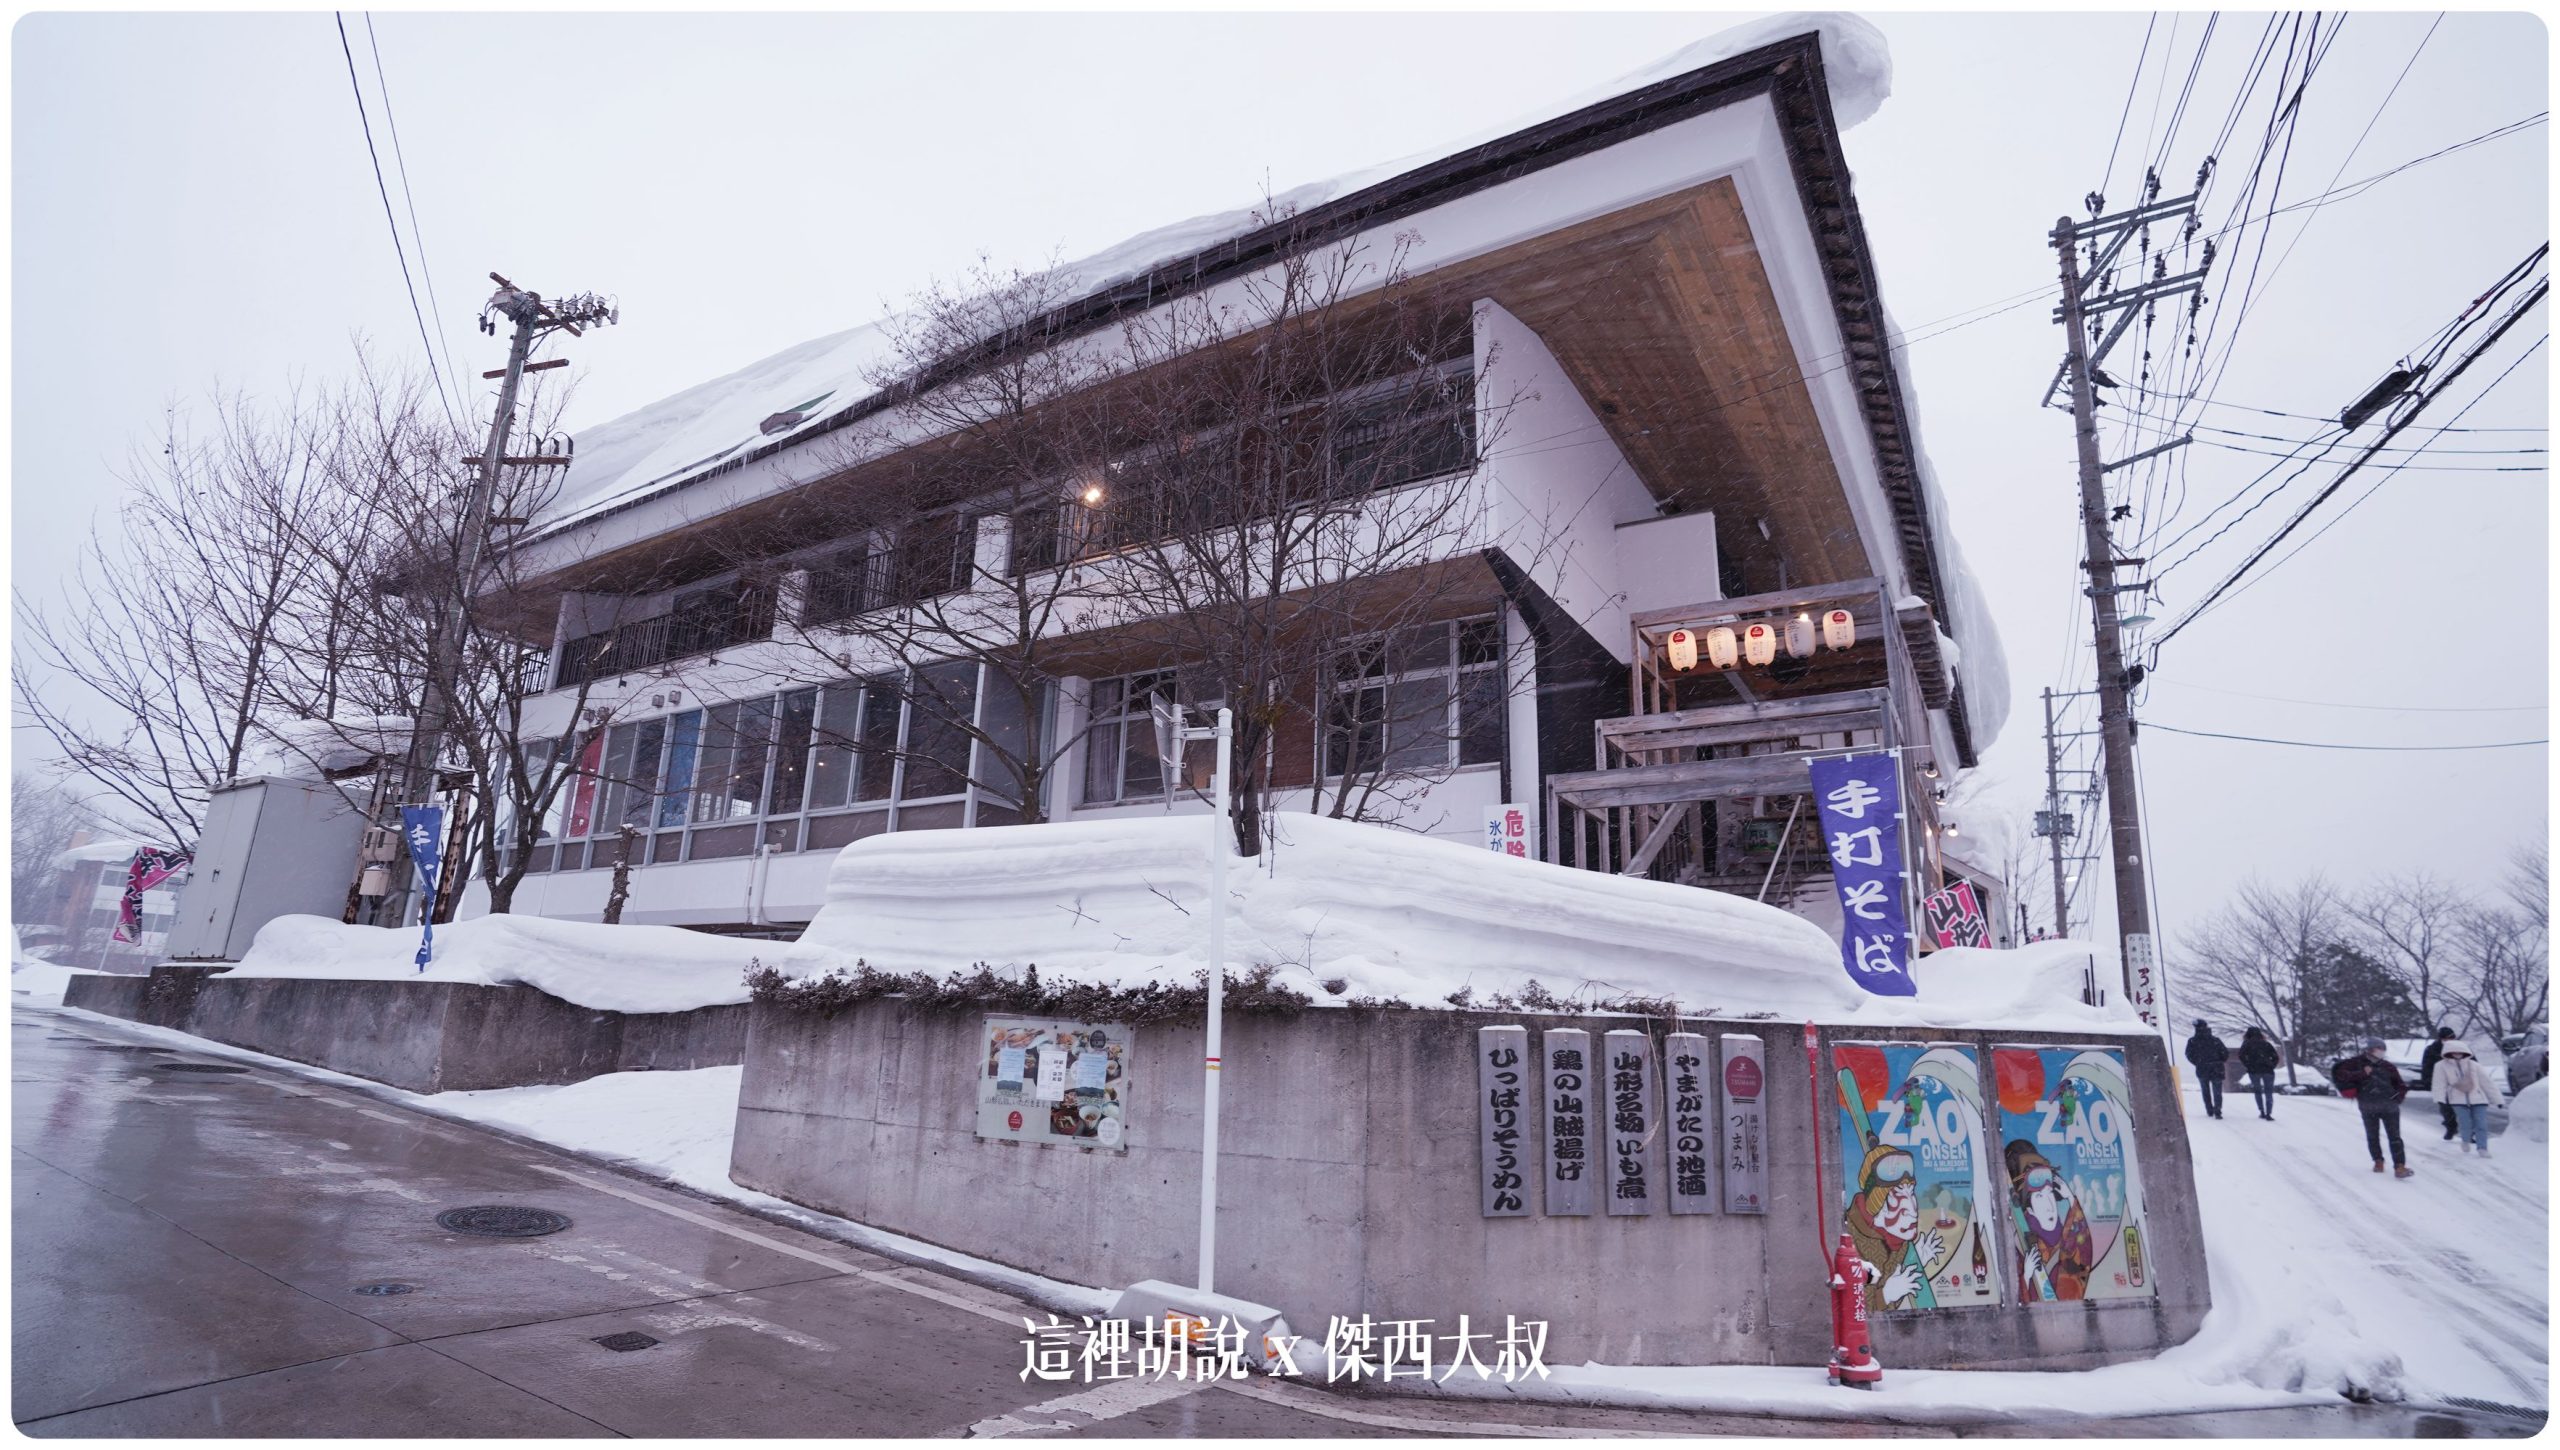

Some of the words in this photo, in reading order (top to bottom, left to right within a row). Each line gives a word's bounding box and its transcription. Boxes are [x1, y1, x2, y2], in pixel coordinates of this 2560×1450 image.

[1827, 779, 1902, 974] 手打そば
[1488, 1048, 1522, 1212] ひっぱりそうめん
[1552, 1050, 1585, 1182] 鶏の山賊揚げ
[1674, 1054, 1707, 1196] やまがたの地酒
[1877, 1099, 1968, 1146] ZAO
[2035, 1099, 2118, 1144] ZAO
[1730, 1115, 1745, 1173] つまみ
[1922, 1144, 1967, 1160] ONSEN
[2077, 1142, 2119, 1158] ONSEN
[1853, 1283, 1866, 1322] 消火栓
